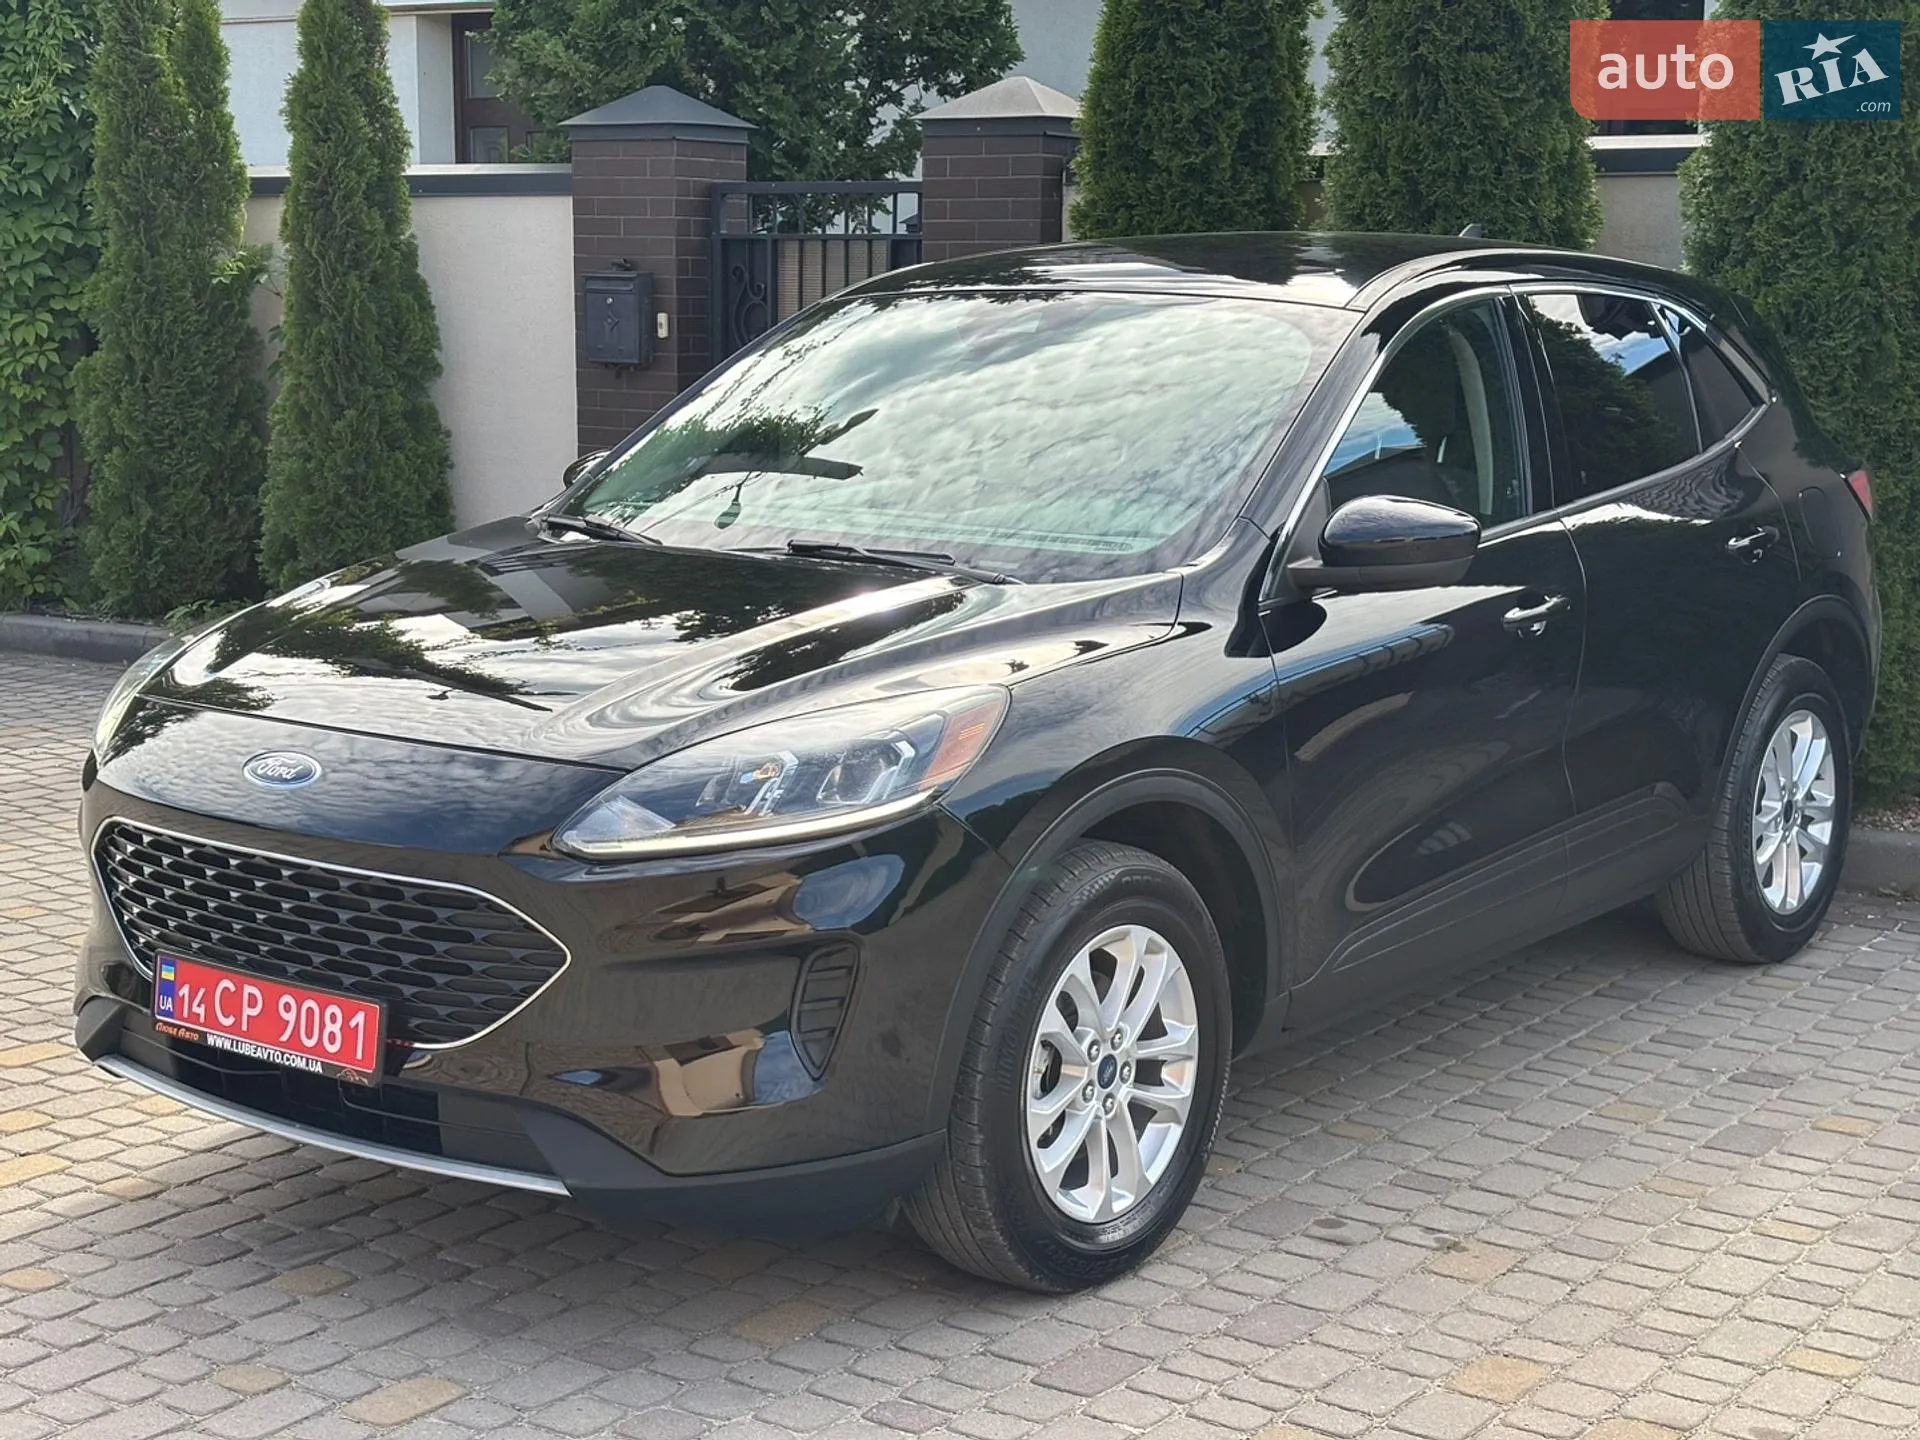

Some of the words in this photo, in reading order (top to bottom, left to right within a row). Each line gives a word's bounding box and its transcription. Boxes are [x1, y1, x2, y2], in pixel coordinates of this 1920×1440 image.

[256, 757, 304, 780] Ford
[160, 994, 173, 1012] UA
[278, 994, 366, 1060] 9081
[206, 1033, 323, 1073] WWW.LUBEAVTO.COM.UA
